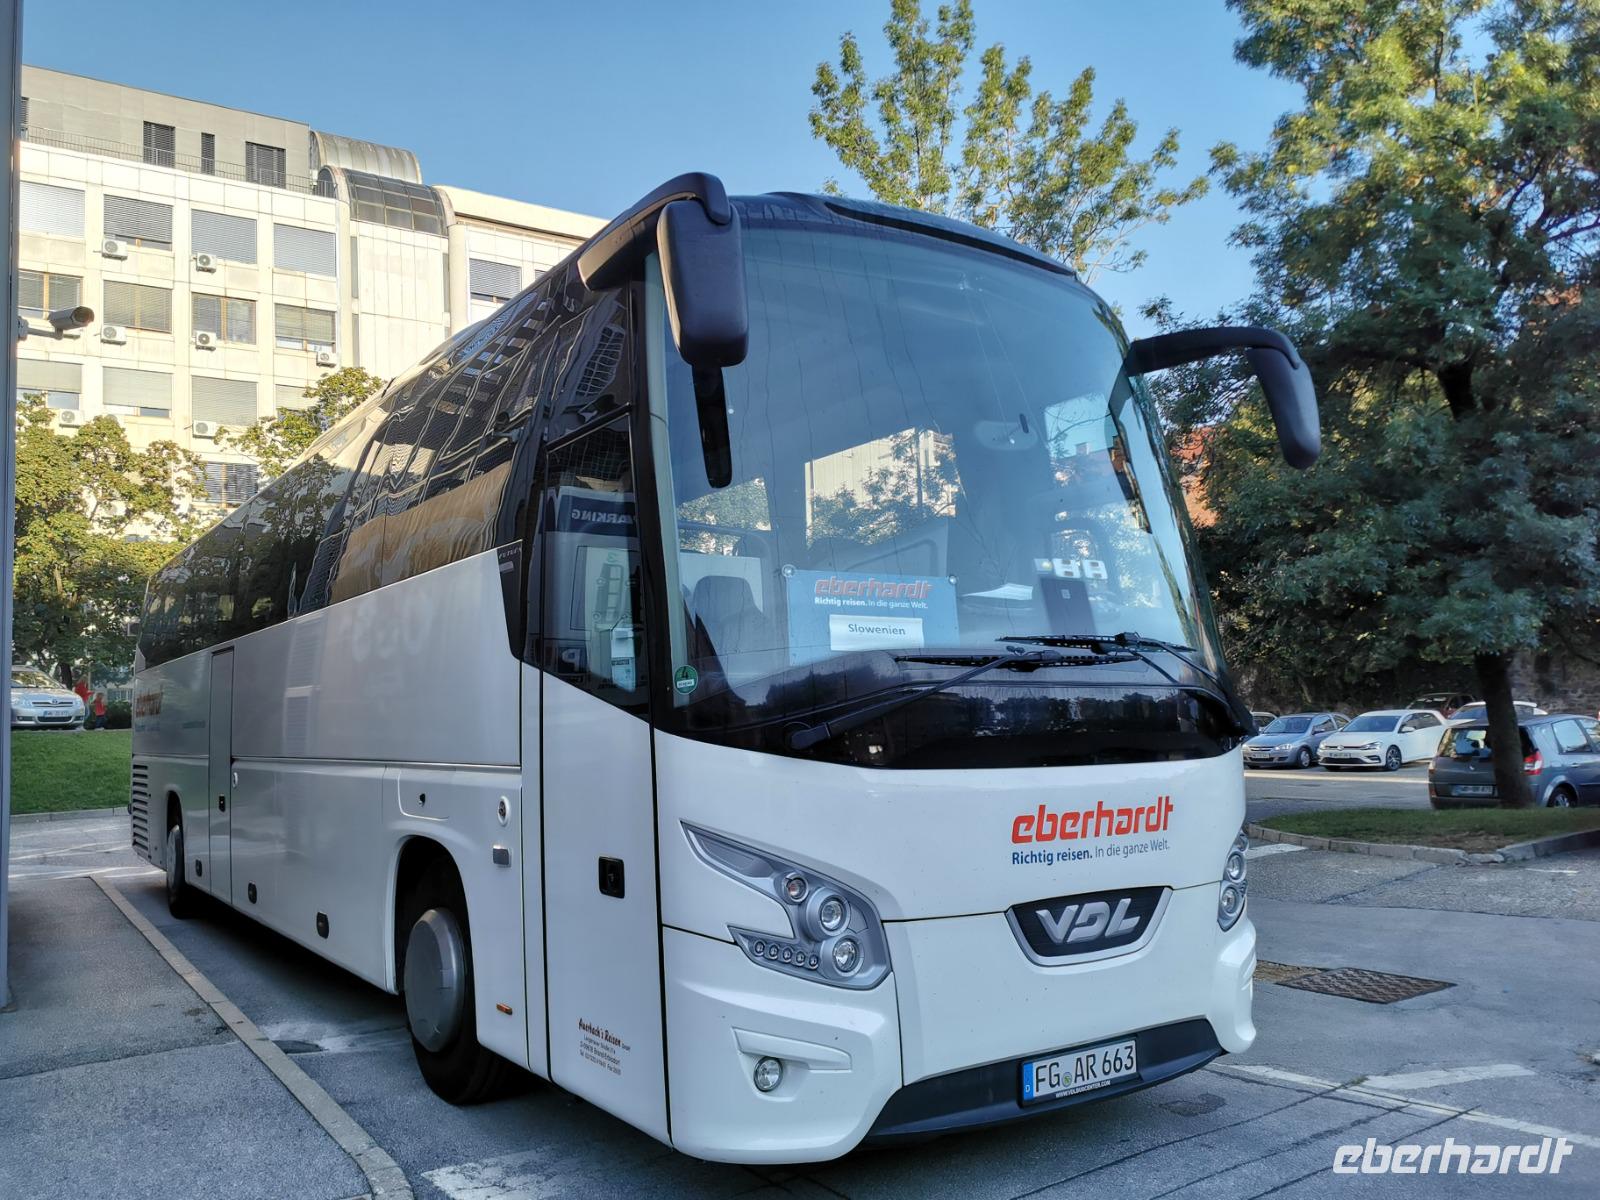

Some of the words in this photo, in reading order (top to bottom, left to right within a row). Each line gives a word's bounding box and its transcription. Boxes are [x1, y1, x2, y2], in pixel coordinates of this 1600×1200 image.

[814, 576, 934, 600] eberhardt
[814, 597, 842, 607] Richtig
[842, 598, 867, 607] reisen.
[868, 599, 876, 607] In
[876, 600, 887, 608] die
[889, 601, 909, 609] ganze
[910, 601, 928, 609] Welt.
[848, 623, 906, 636] Slowenien
[1011, 796, 1174, 844] eberhardt
[1012, 851, 1054, 866] Richtig
[1057, 848, 1093, 861] reisen.
[1095, 845, 1104, 858] In
[1106, 843, 1120, 856] die
[1122, 844, 1149, 858] ganze
[1150, 838, 1170, 851] Welt.
[1035, 897, 1141, 945] VDL
[1035, 1061, 1060, 1093] FG
[1074, 1053, 1097, 1083] AR
[1102, 1045, 1134, 1076] 663
[1025, 1084, 1031, 1093] D
